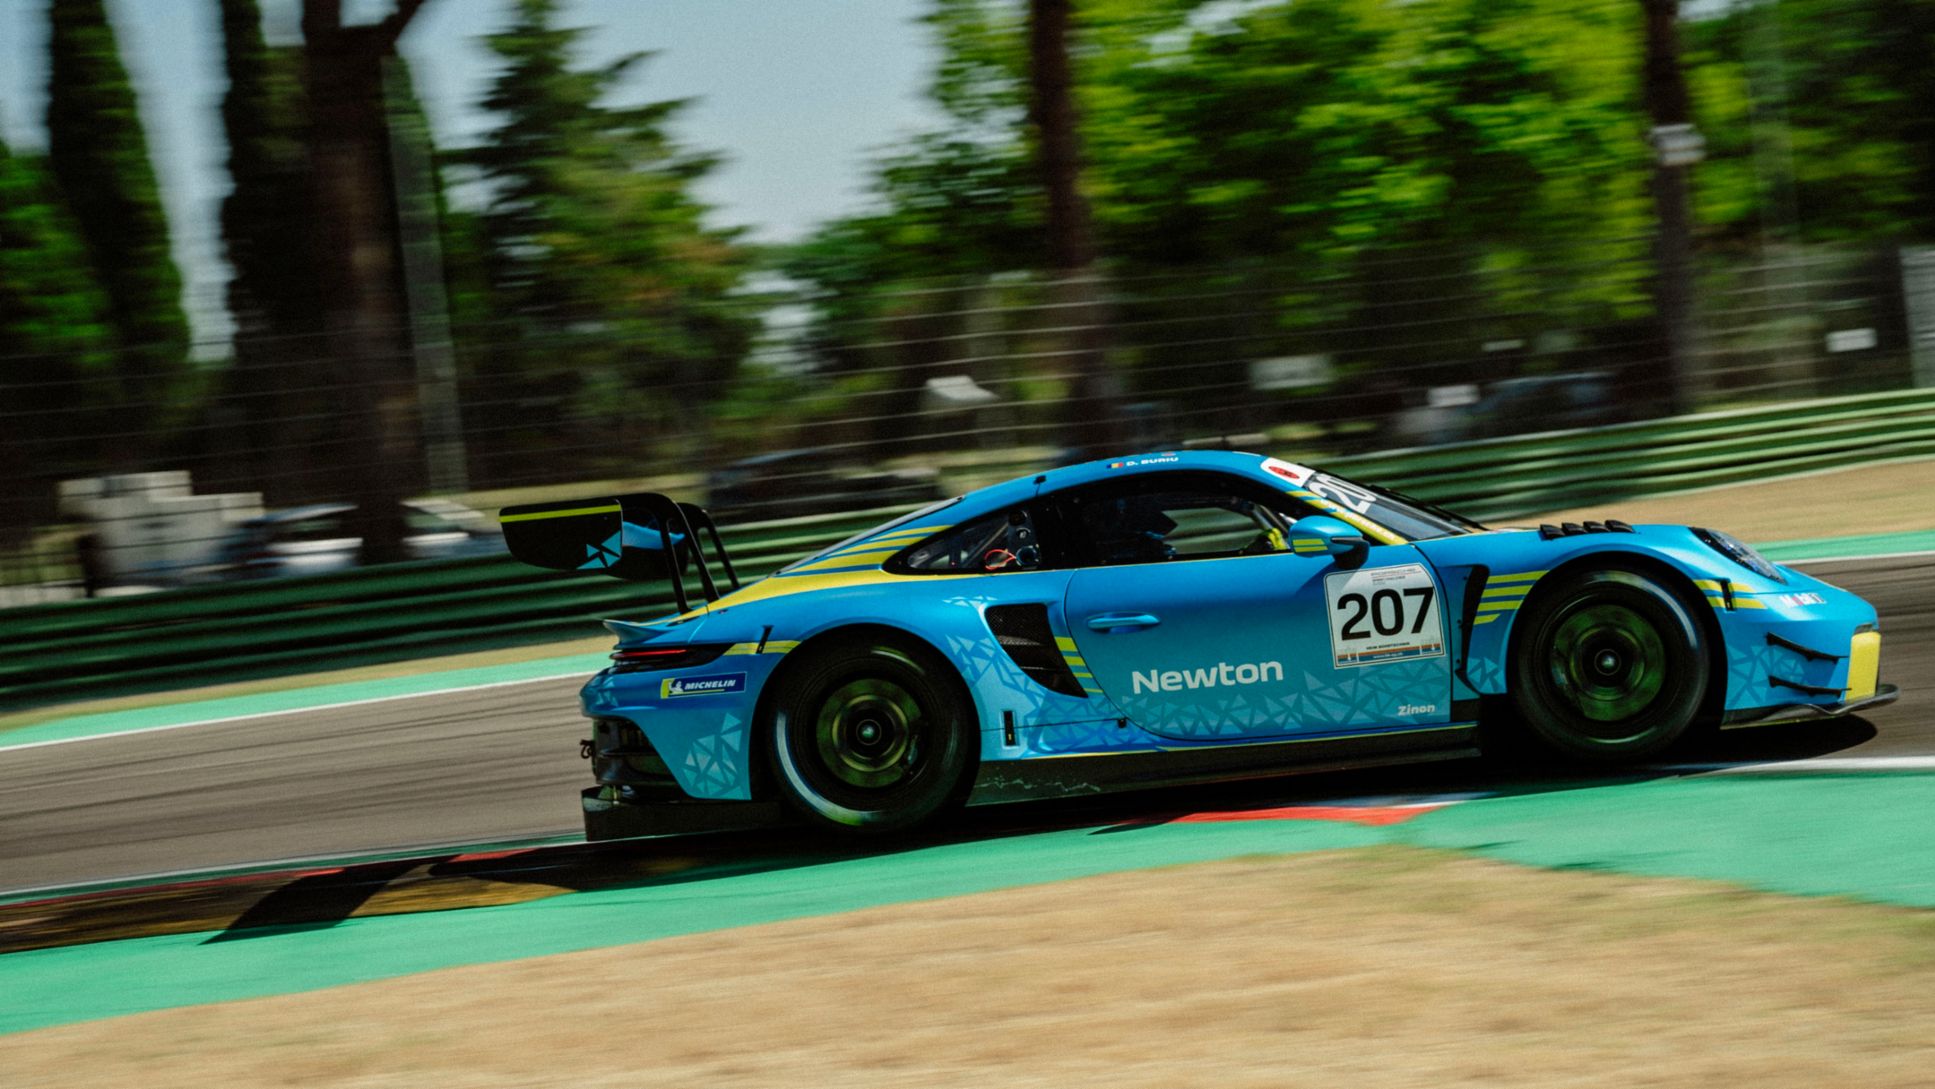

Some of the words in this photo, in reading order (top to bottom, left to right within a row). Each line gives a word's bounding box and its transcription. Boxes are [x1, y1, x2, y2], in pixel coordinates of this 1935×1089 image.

[1337, 586, 1434, 641] 207
[684, 679, 737, 691] MICHELIN
[1132, 660, 1284, 695] Newton
[1397, 703, 1436, 717] Zinon
